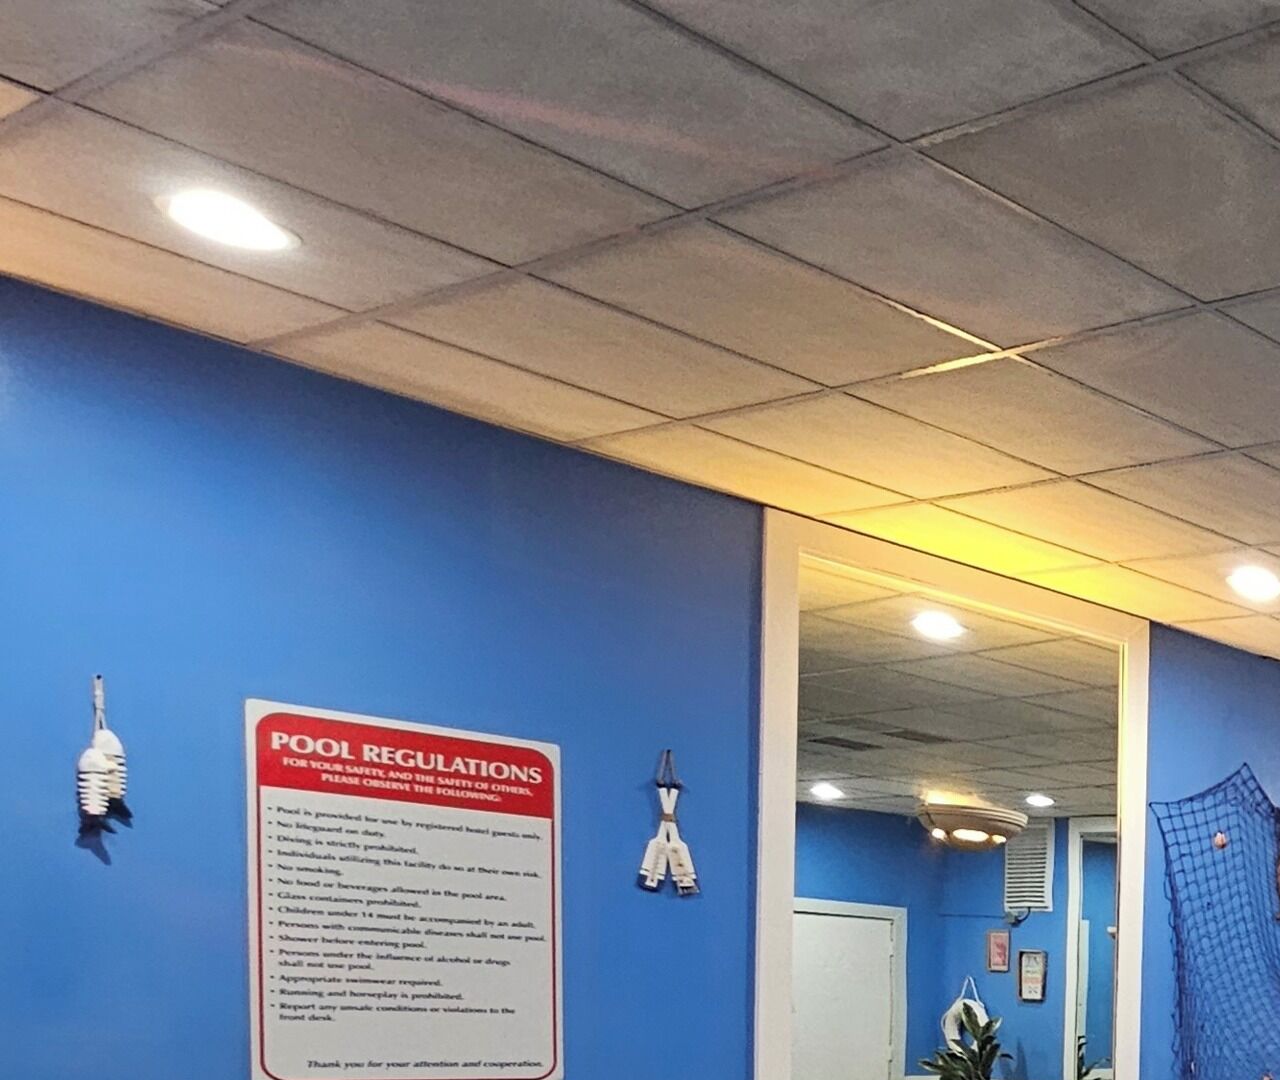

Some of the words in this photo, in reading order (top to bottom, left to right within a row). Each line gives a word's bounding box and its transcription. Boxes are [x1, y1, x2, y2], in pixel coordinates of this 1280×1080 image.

[271, 731, 356, 760] POOL
[362, 743, 544, 785] REGULATIONS
[283, 757, 309, 769] FOR
[310, 760, 344, 773] YOUR
[387, 769, 413, 781] AND
[415, 773, 436, 784] THE
[437, 776, 473, 789] SAFETY
[321, 773, 361, 786] PLEASE
[362, 779, 411, 791] OBSERVE
[413, 783, 435, 795] THE
